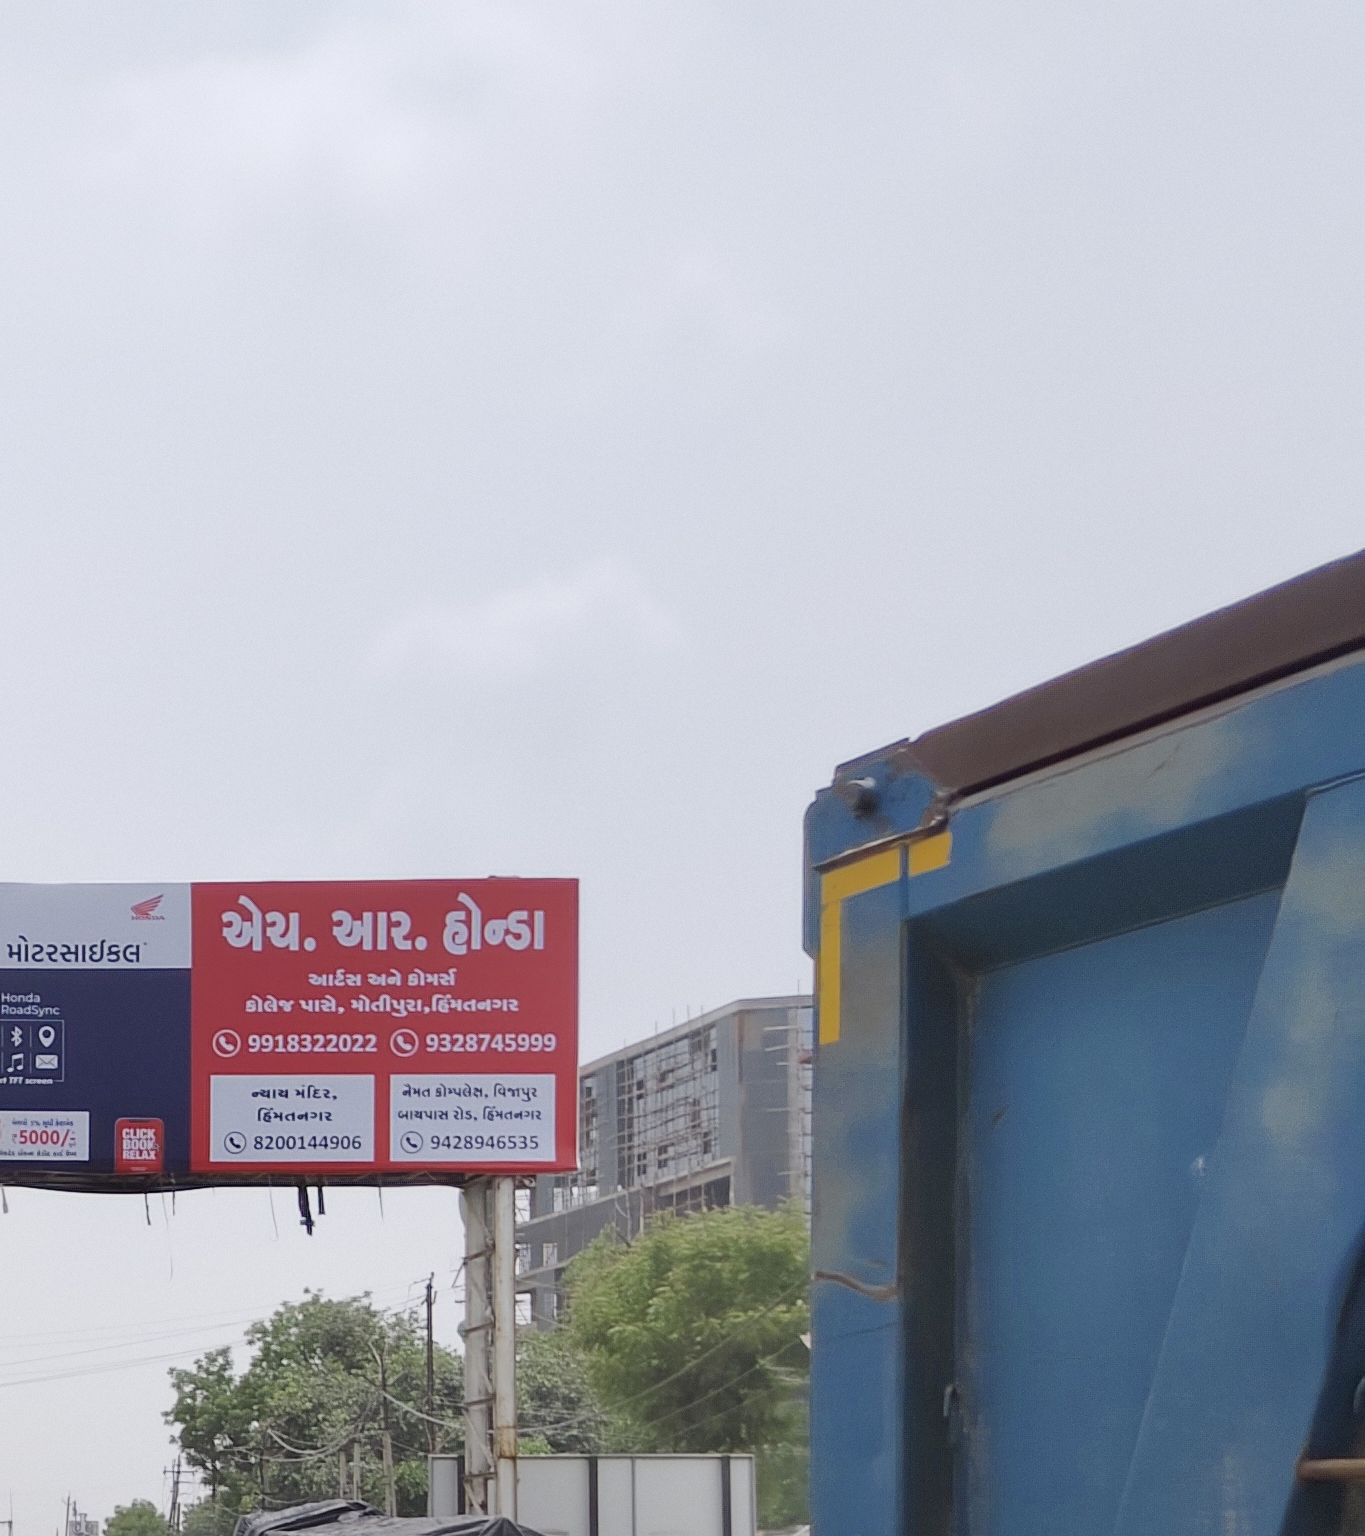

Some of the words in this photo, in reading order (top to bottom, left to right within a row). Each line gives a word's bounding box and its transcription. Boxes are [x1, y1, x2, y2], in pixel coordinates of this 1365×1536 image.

[221, 894, 316, 952] એચ.
[332, 909, 428, 952] આર.
[442, 892, 545, 955] હોન્ડા
[308, 968, 362, 987] આર્ટસ
[367, 968, 402, 987] અને
[407, 967, 457, 987] કોમર્સ
[1, 993, 41, 1004] Honda
[245, 994, 294, 1013] કોલેજ
[299, 994, 345, 1014] પાસે,
[1, 1005, 60, 1018] RoadSync
[248, 1033, 378, 1053] 9918322022
[425, 1033, 557, 1052] 9328745999
[251, 1087, 289, 1100] ન્યાય
[493, 1083, 538, 1102] વિજાપુર
[257, 1107, 333, 1123] હિંમતનગર
[398, 1109, 449, 1121] બાયપાસ
[483, 1106, 543, 1122] હિંમતનગર
[122, 1128, 156, 1139] CLICK
[123, 1139, 154, 1150] BOOK
[253, 1134, 362, 1151] 8200144906
[430, 1134, 539, 1150] 9428946535
[123, 1150, 156, 1160] RELAX
